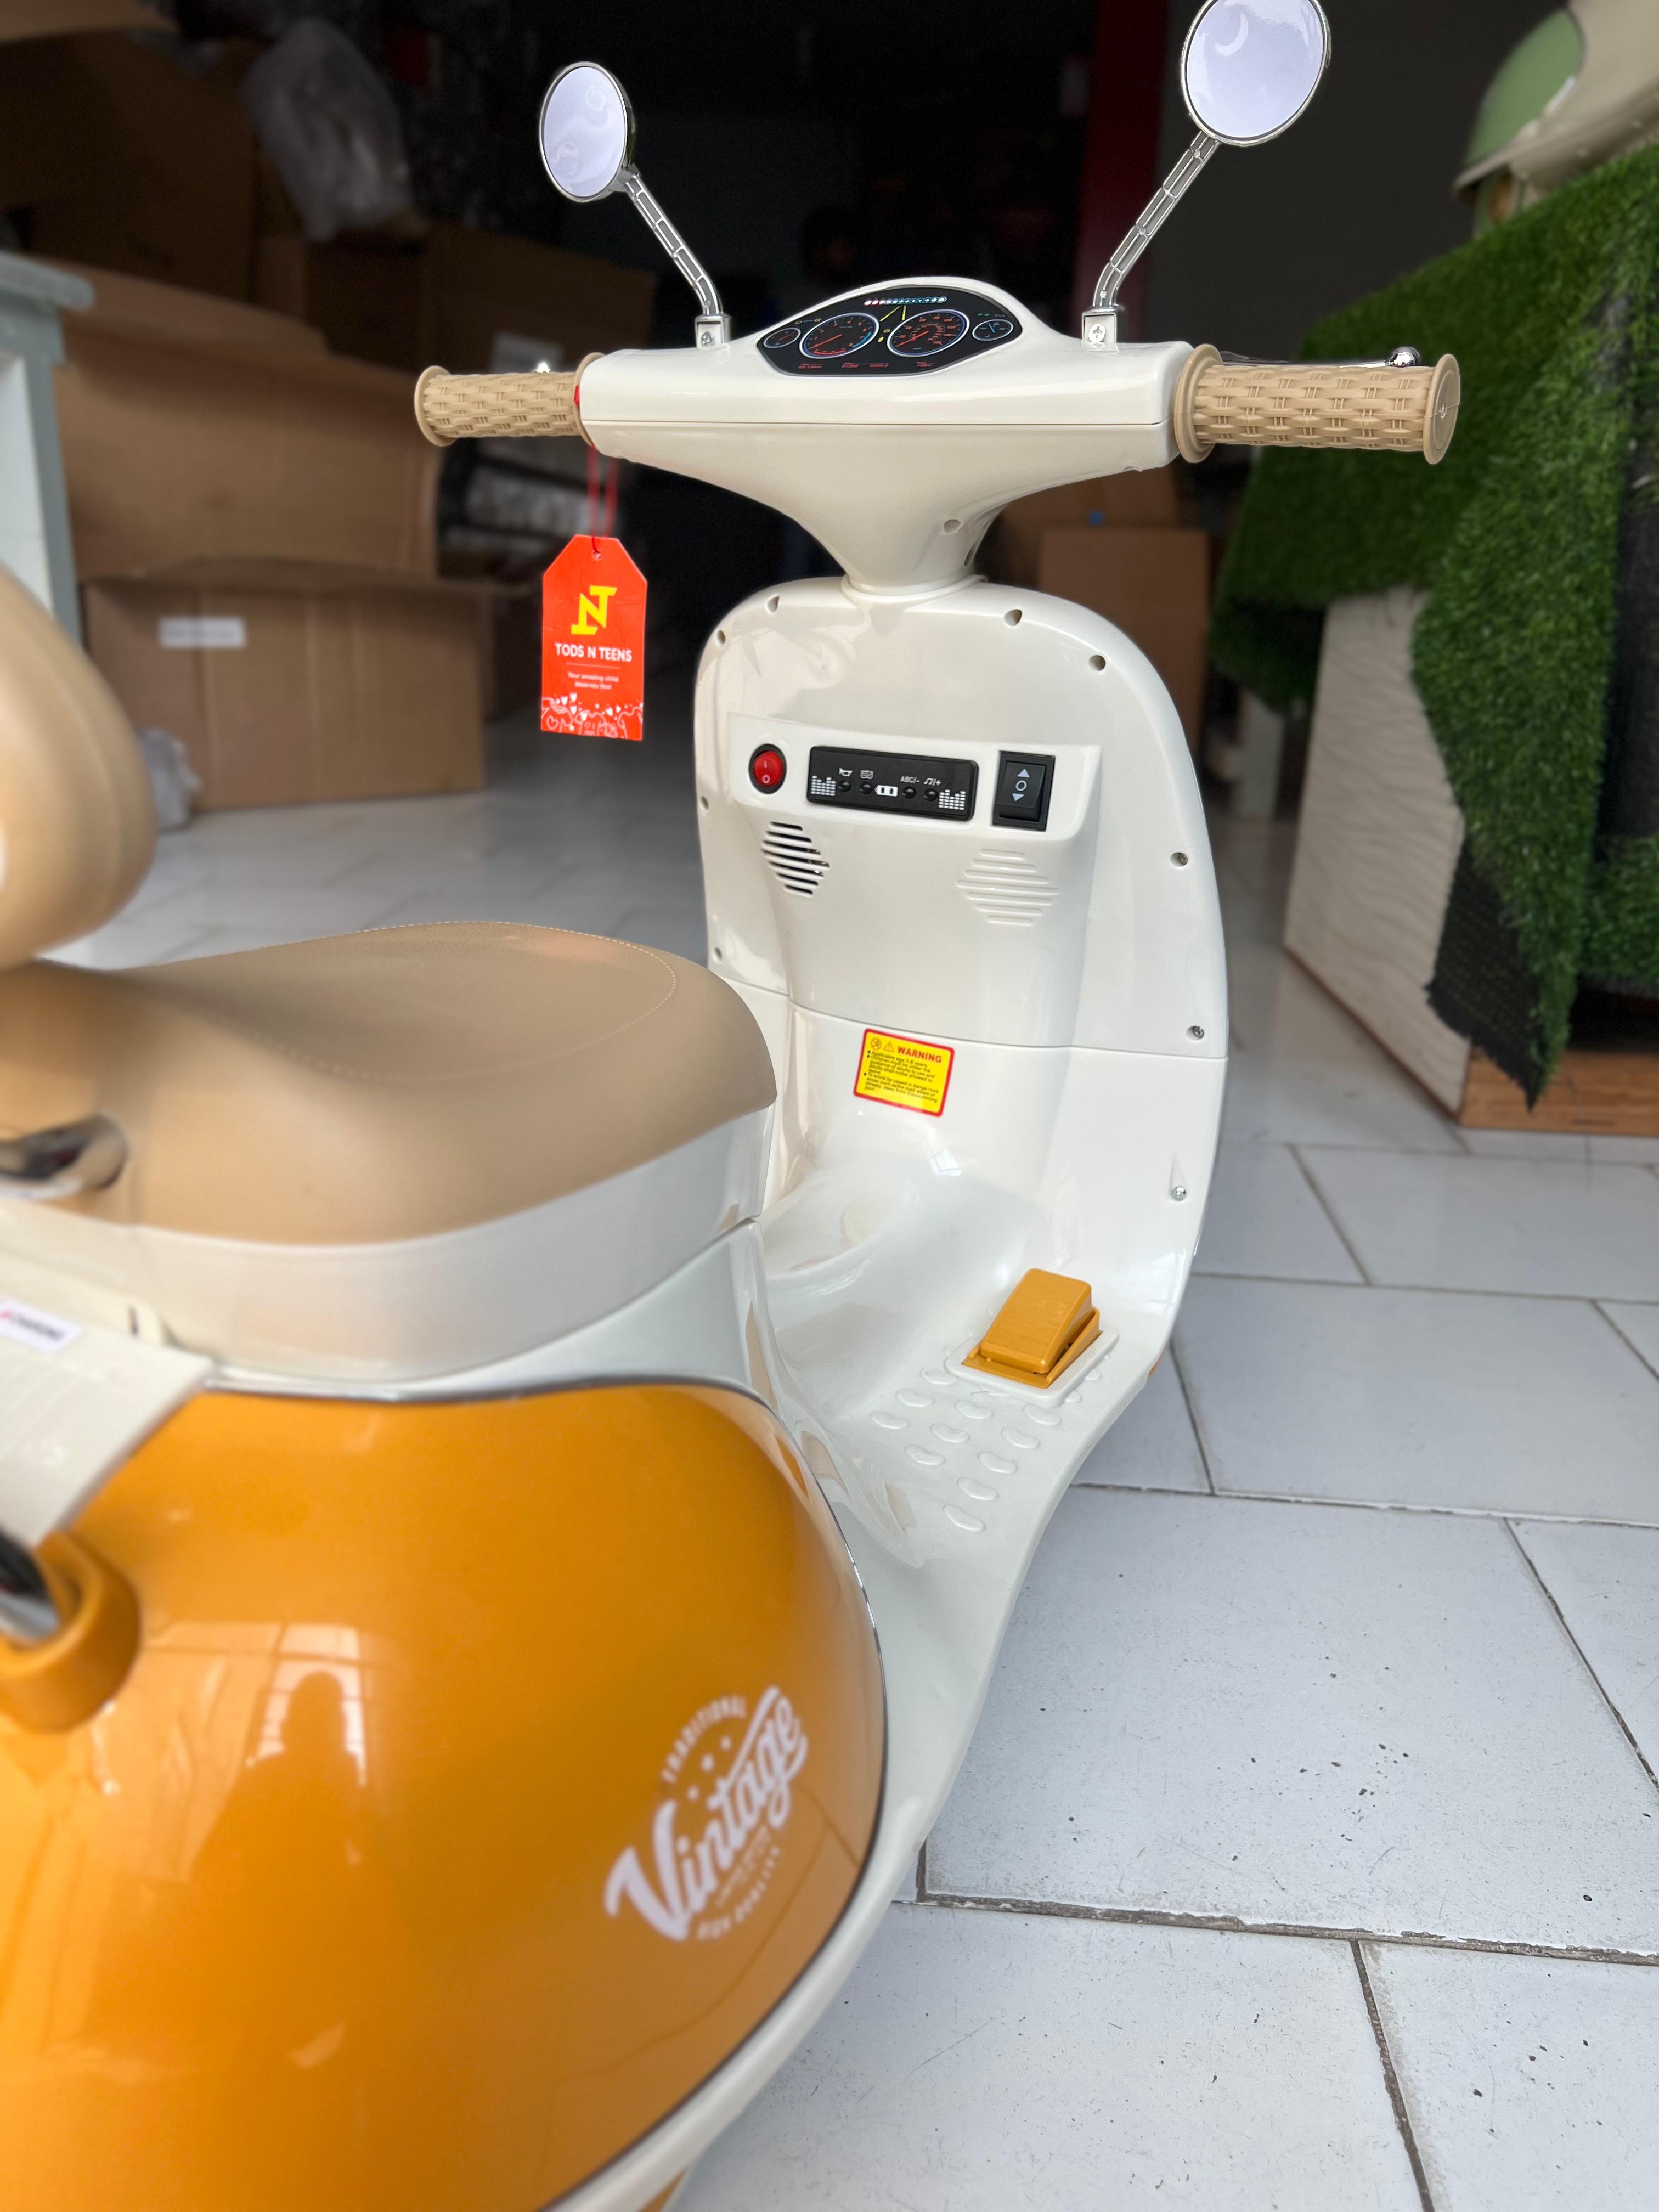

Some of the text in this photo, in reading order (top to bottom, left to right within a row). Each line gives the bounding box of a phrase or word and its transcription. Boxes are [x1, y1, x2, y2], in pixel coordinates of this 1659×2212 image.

[555, 642, 633, 662] TODS N TEENS
[897, 1046, 942, 1063] WARNING
[603, 1685, 808, 1943] Vintage
